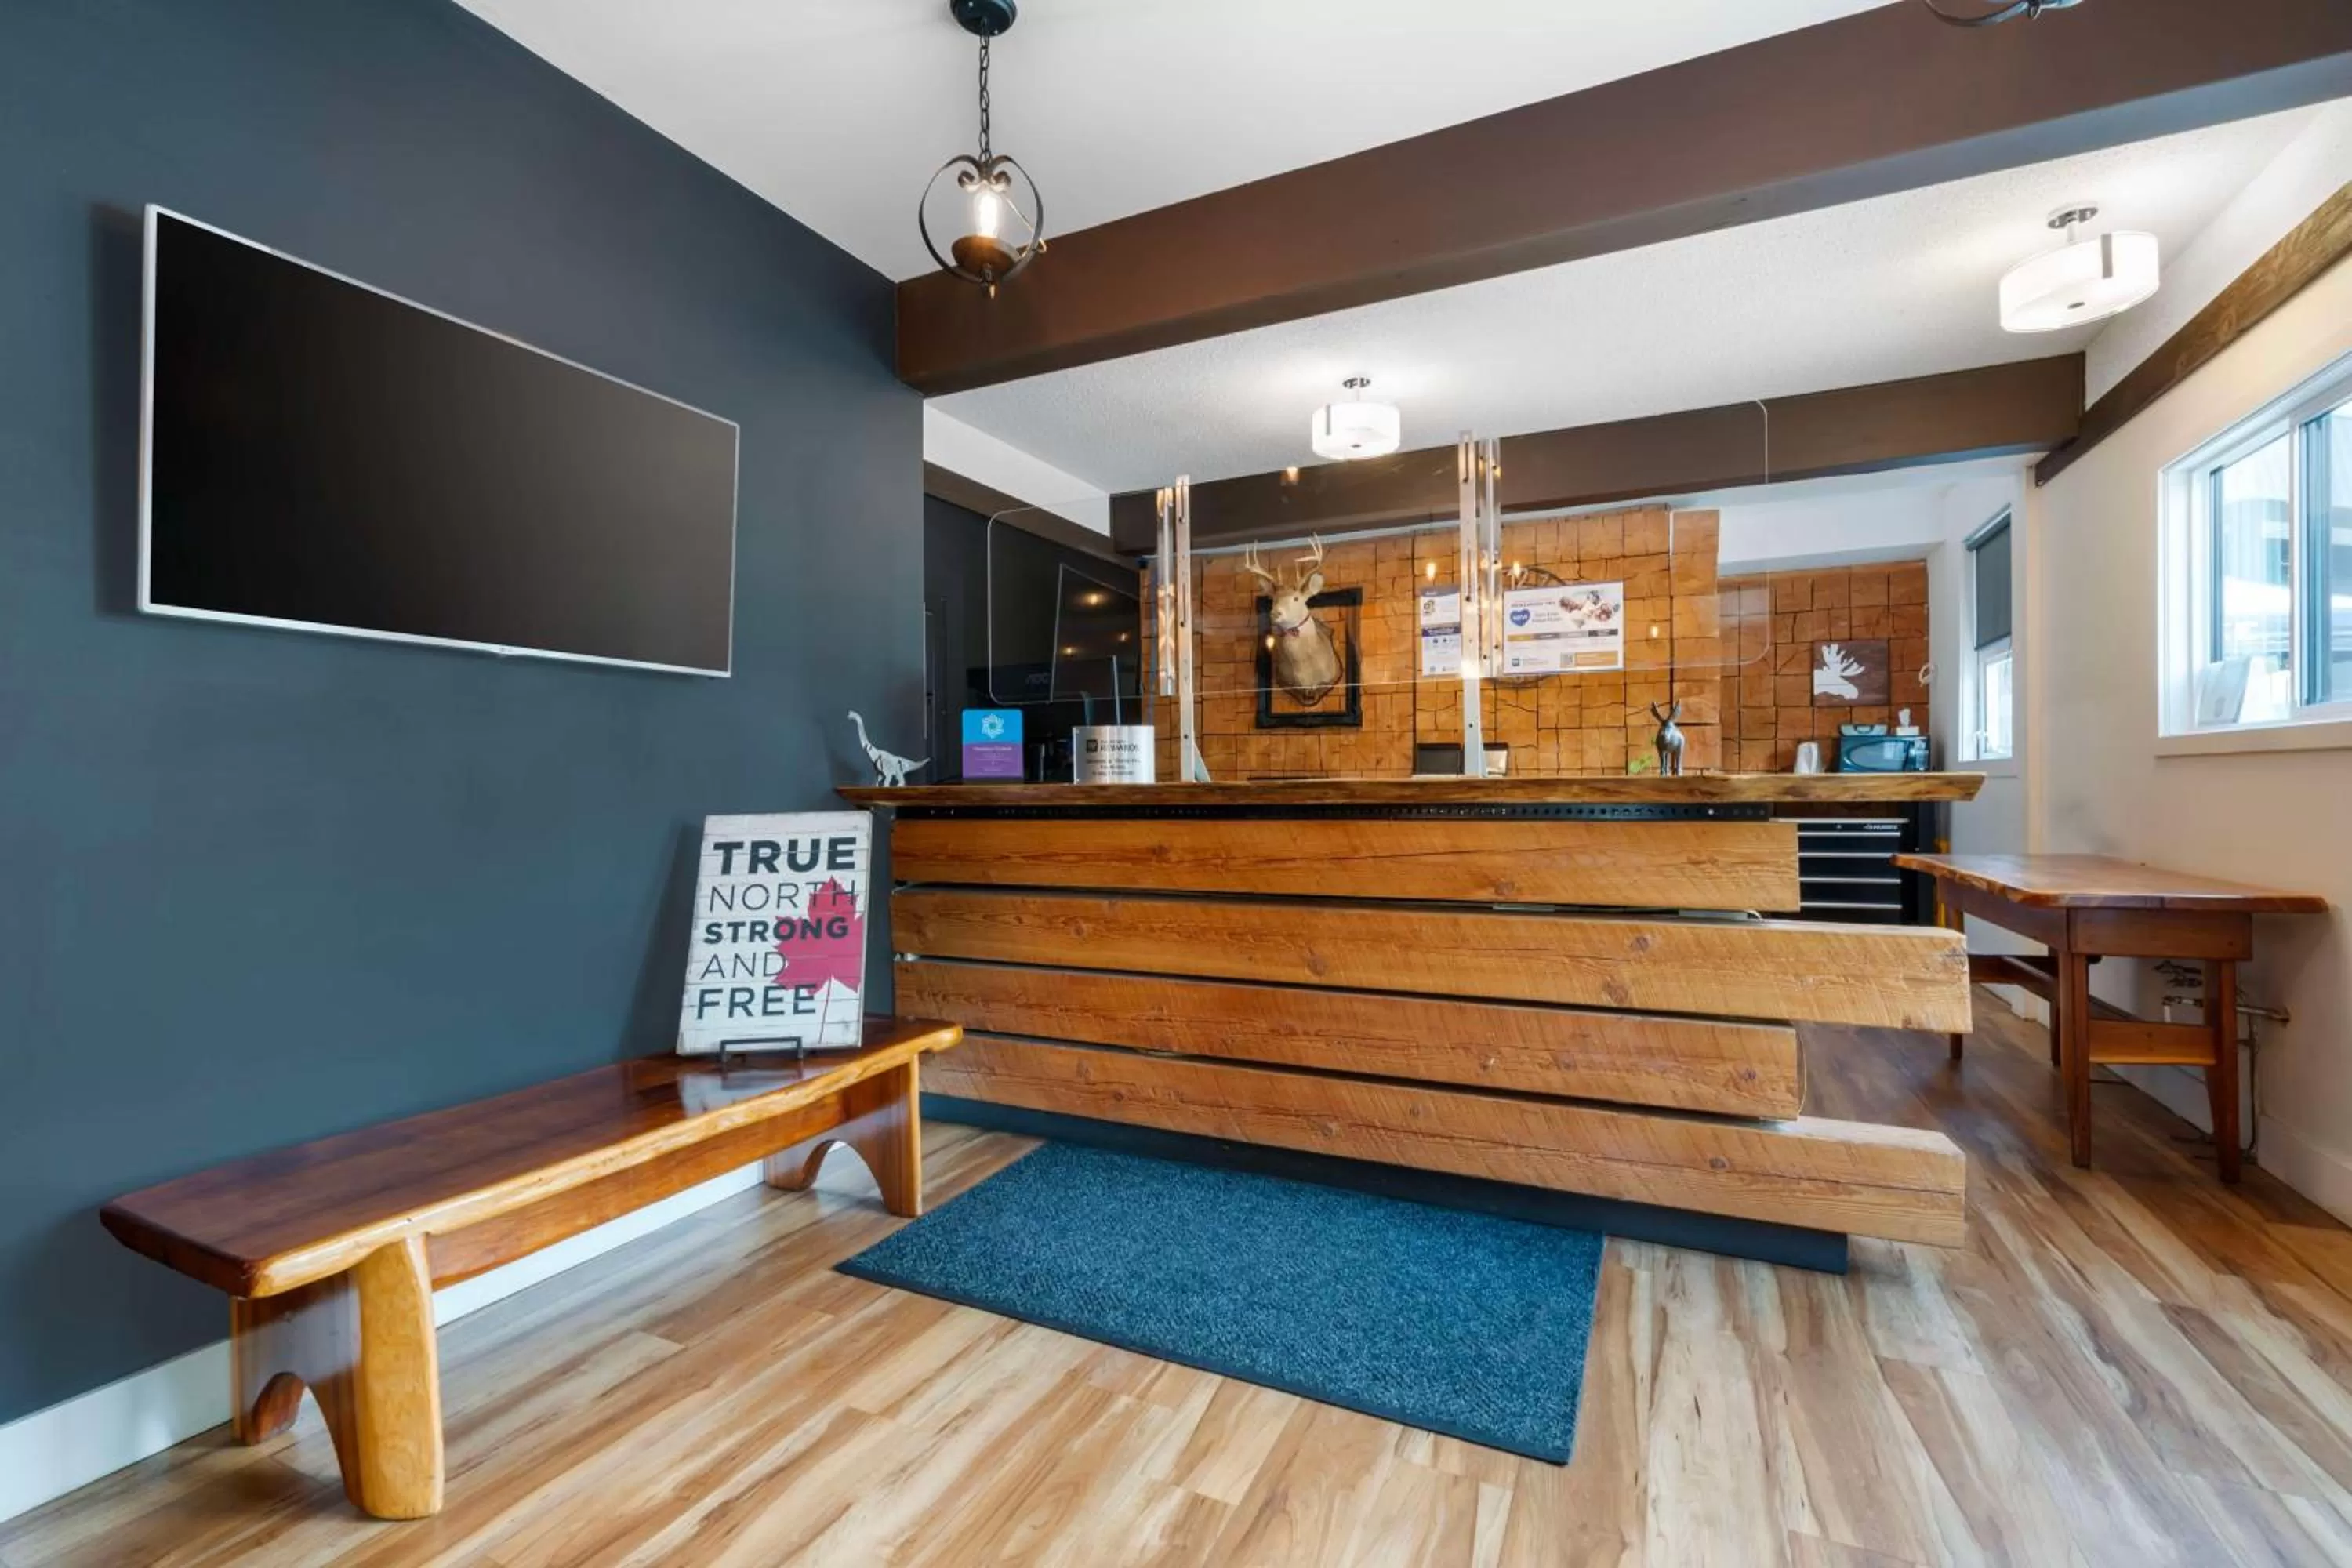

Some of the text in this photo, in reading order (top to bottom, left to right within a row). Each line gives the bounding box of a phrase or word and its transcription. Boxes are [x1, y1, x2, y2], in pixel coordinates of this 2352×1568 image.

[713, 837, 856, 876] TRUE
[709, 880, 855, 913] NORTH
[704, 916, 849, 945] STRONG
[699, 951, 786, 980] AND
[696, 984, 817, 1020] FREE
